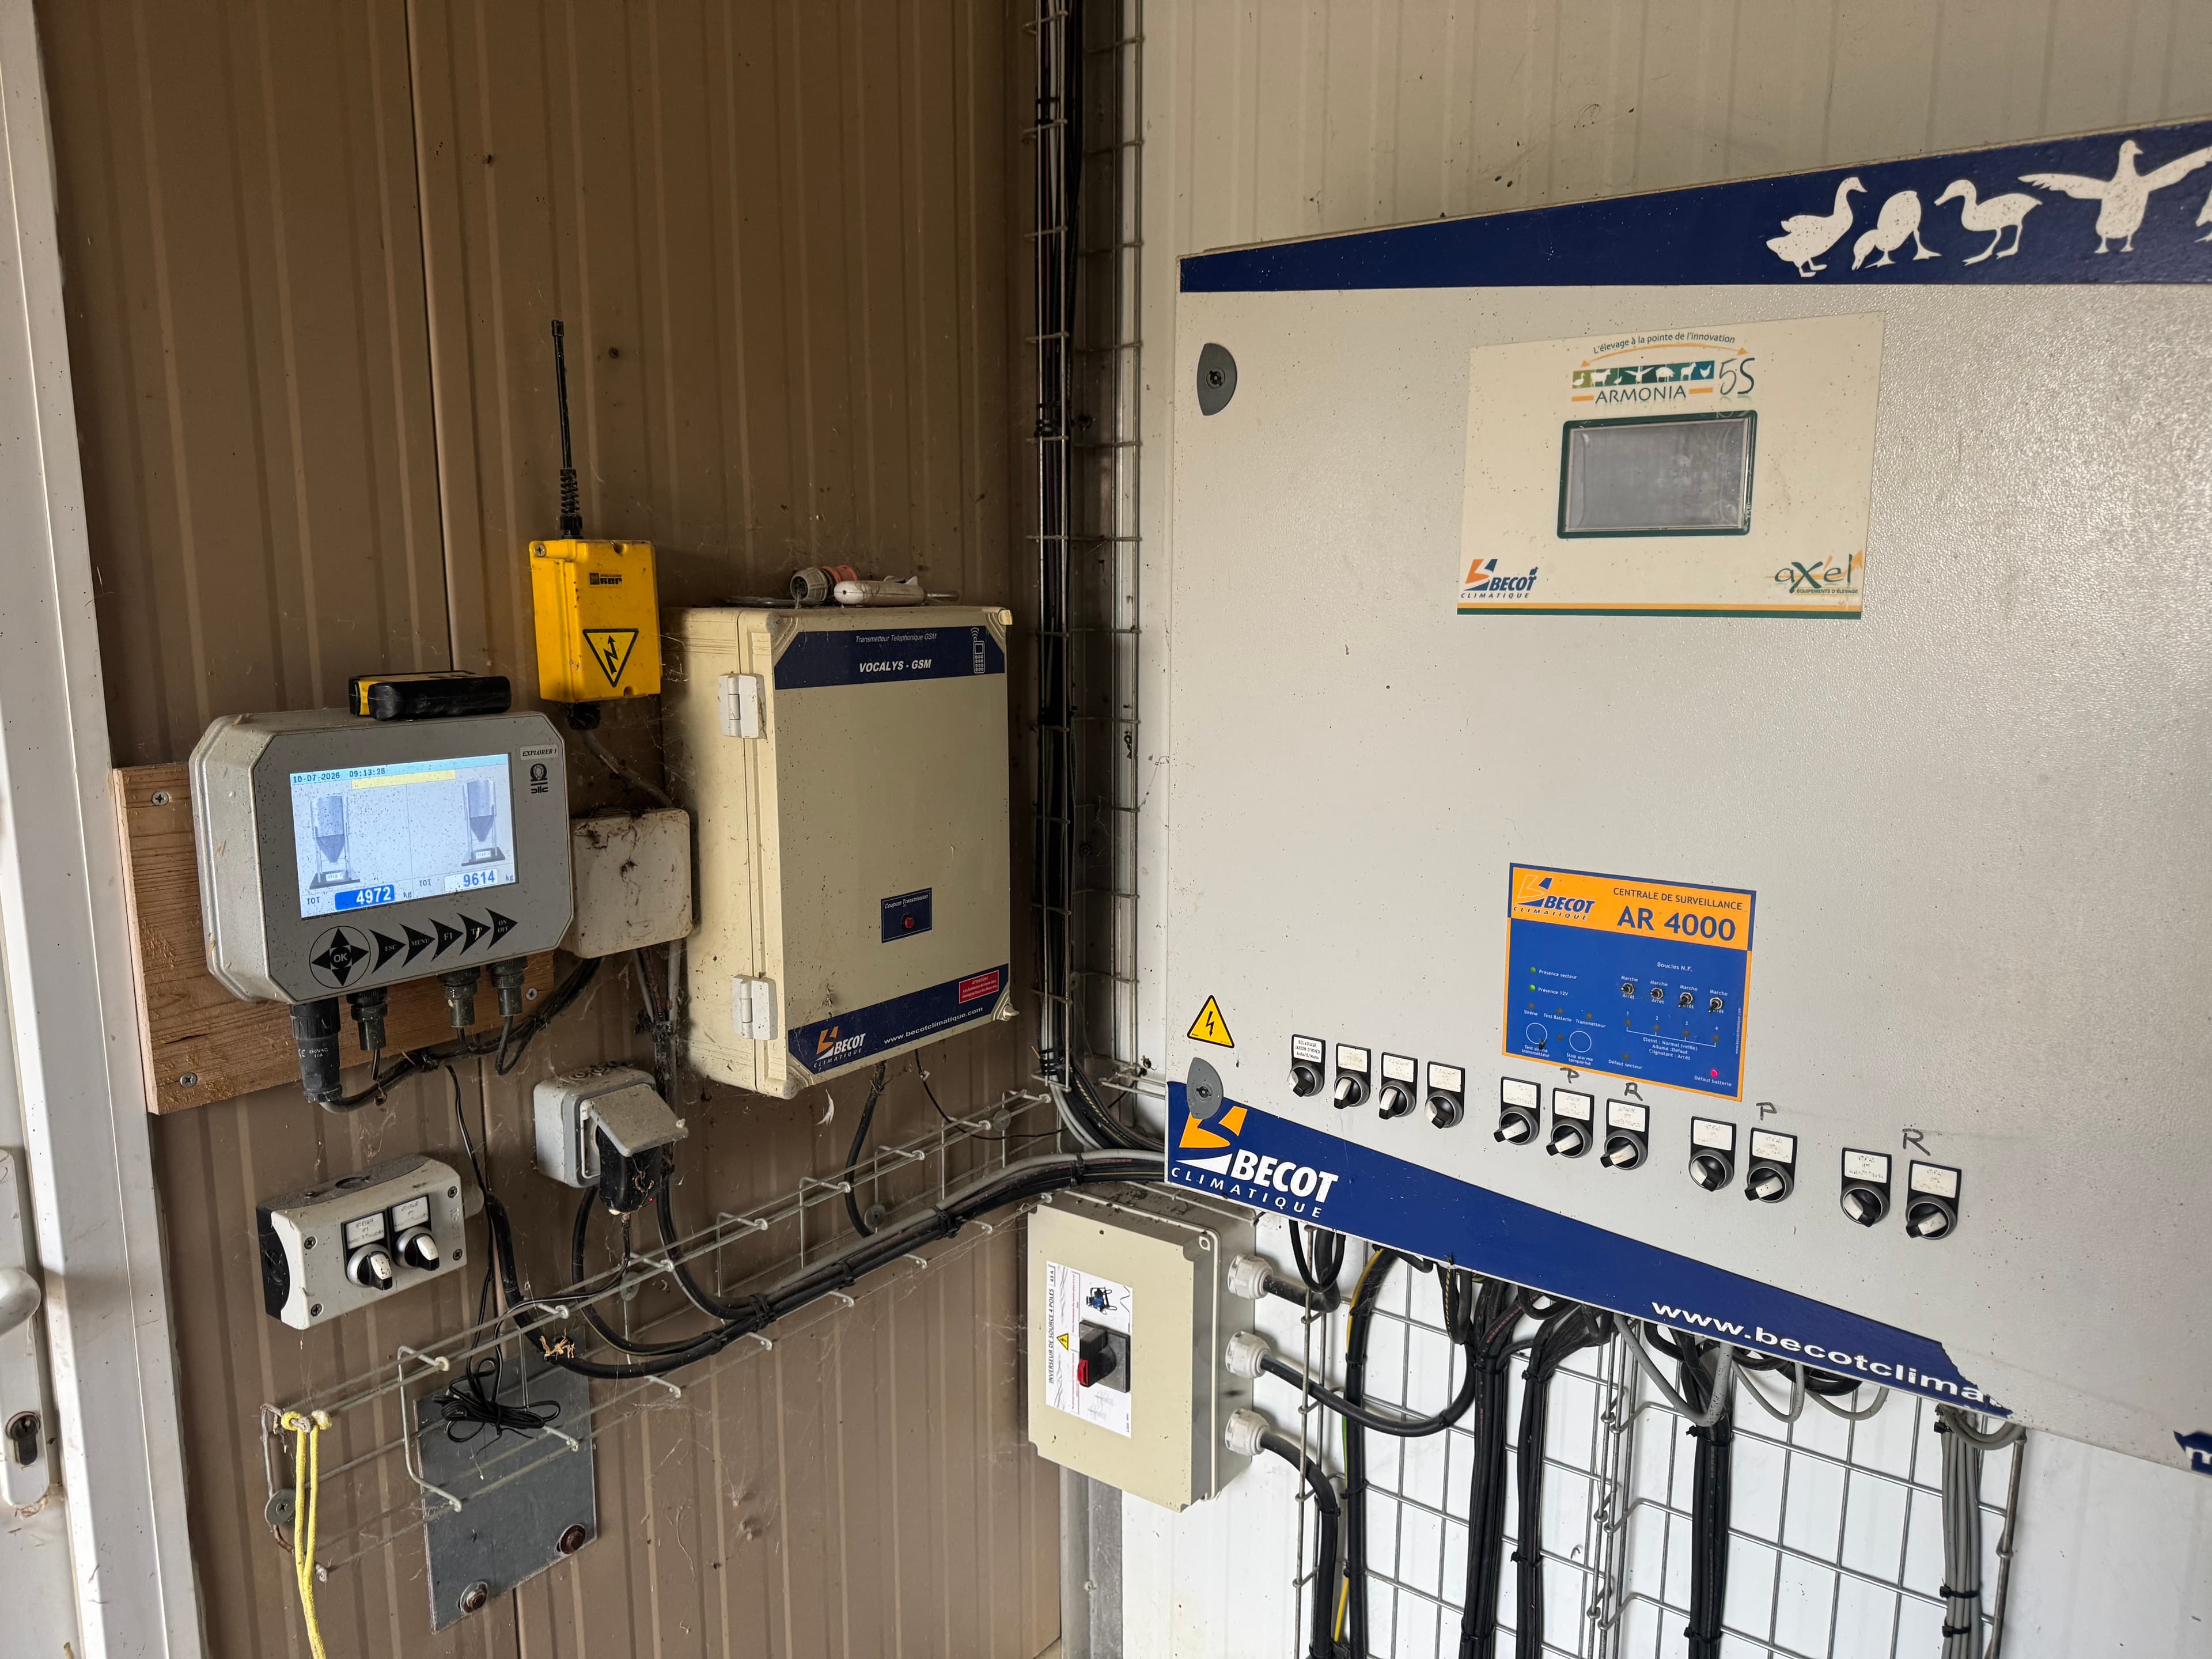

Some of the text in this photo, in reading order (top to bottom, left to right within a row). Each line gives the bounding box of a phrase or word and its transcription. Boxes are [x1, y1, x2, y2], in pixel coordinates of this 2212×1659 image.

[1593, 331, 1735, 354] L'élevage à la pointe de l'innovation
[1595, 385, 1687, 404] ARMONIA
[1489, 576, 1537, 591] BECOT
[859, 660, 904, 673] VOCALYS
[911, 659, 932, 669] GSM
[293, 772, 340, 783] 10-07-2026
[419, 879, 431, 887] TOT
[463, 870, 495, 887] 9614
[306, 886, 412, 905] TOT 4972 kg
[1613, 887, 1743, 910] CENTRALE DE SURVEILLANCE
[1513, 906, 1588, 921] CLIMATIQUE
[1544, 895, 1595, 915] BECOT
[1618, 905, 1736, 941] AR 4000
[411, 938, 429, 946] MENU
[444, 933, 453, 941] F1
[385, 944, 397, 952] ESC
[334, 952, 348, 963] OK
[1657, 961, 1679, 970] Boucles
[884, 1007, 983, 1044] www.becotclimatique.com
[1554, 1014, 1572, 1022] Batterie
[1575, 1018, 1606, 1028] Transmetteur
[834, 1033, 866, 1055] BECOT
[1662, 1040, 1679, 1048] Normal
[1680, 1043, 1698, 1051] (veille)
[813, 1048, 862, 1068] CLIMATIQUE
[1521, 1049, 1550, 1058] transmetteur
[1649, 1049, 1673, 1058] Clignotant
[1559, 1067, 1580, 1084] P
[1711, 1078, 1732, 1086] batterie
[1624, 1082, 1643, 1101] R
[1756, 1101, 1777, 1120] P
[1902, 1127, 1931, 1156] R
[1230, 1149, 1339, 1204] BECOT
[1171, 1167, 1323, 1218] CLIMATIQUE
[1048, 1340, 1054, 1349] DE
[1651, 1301, 2002, 1408] www.becotclima
